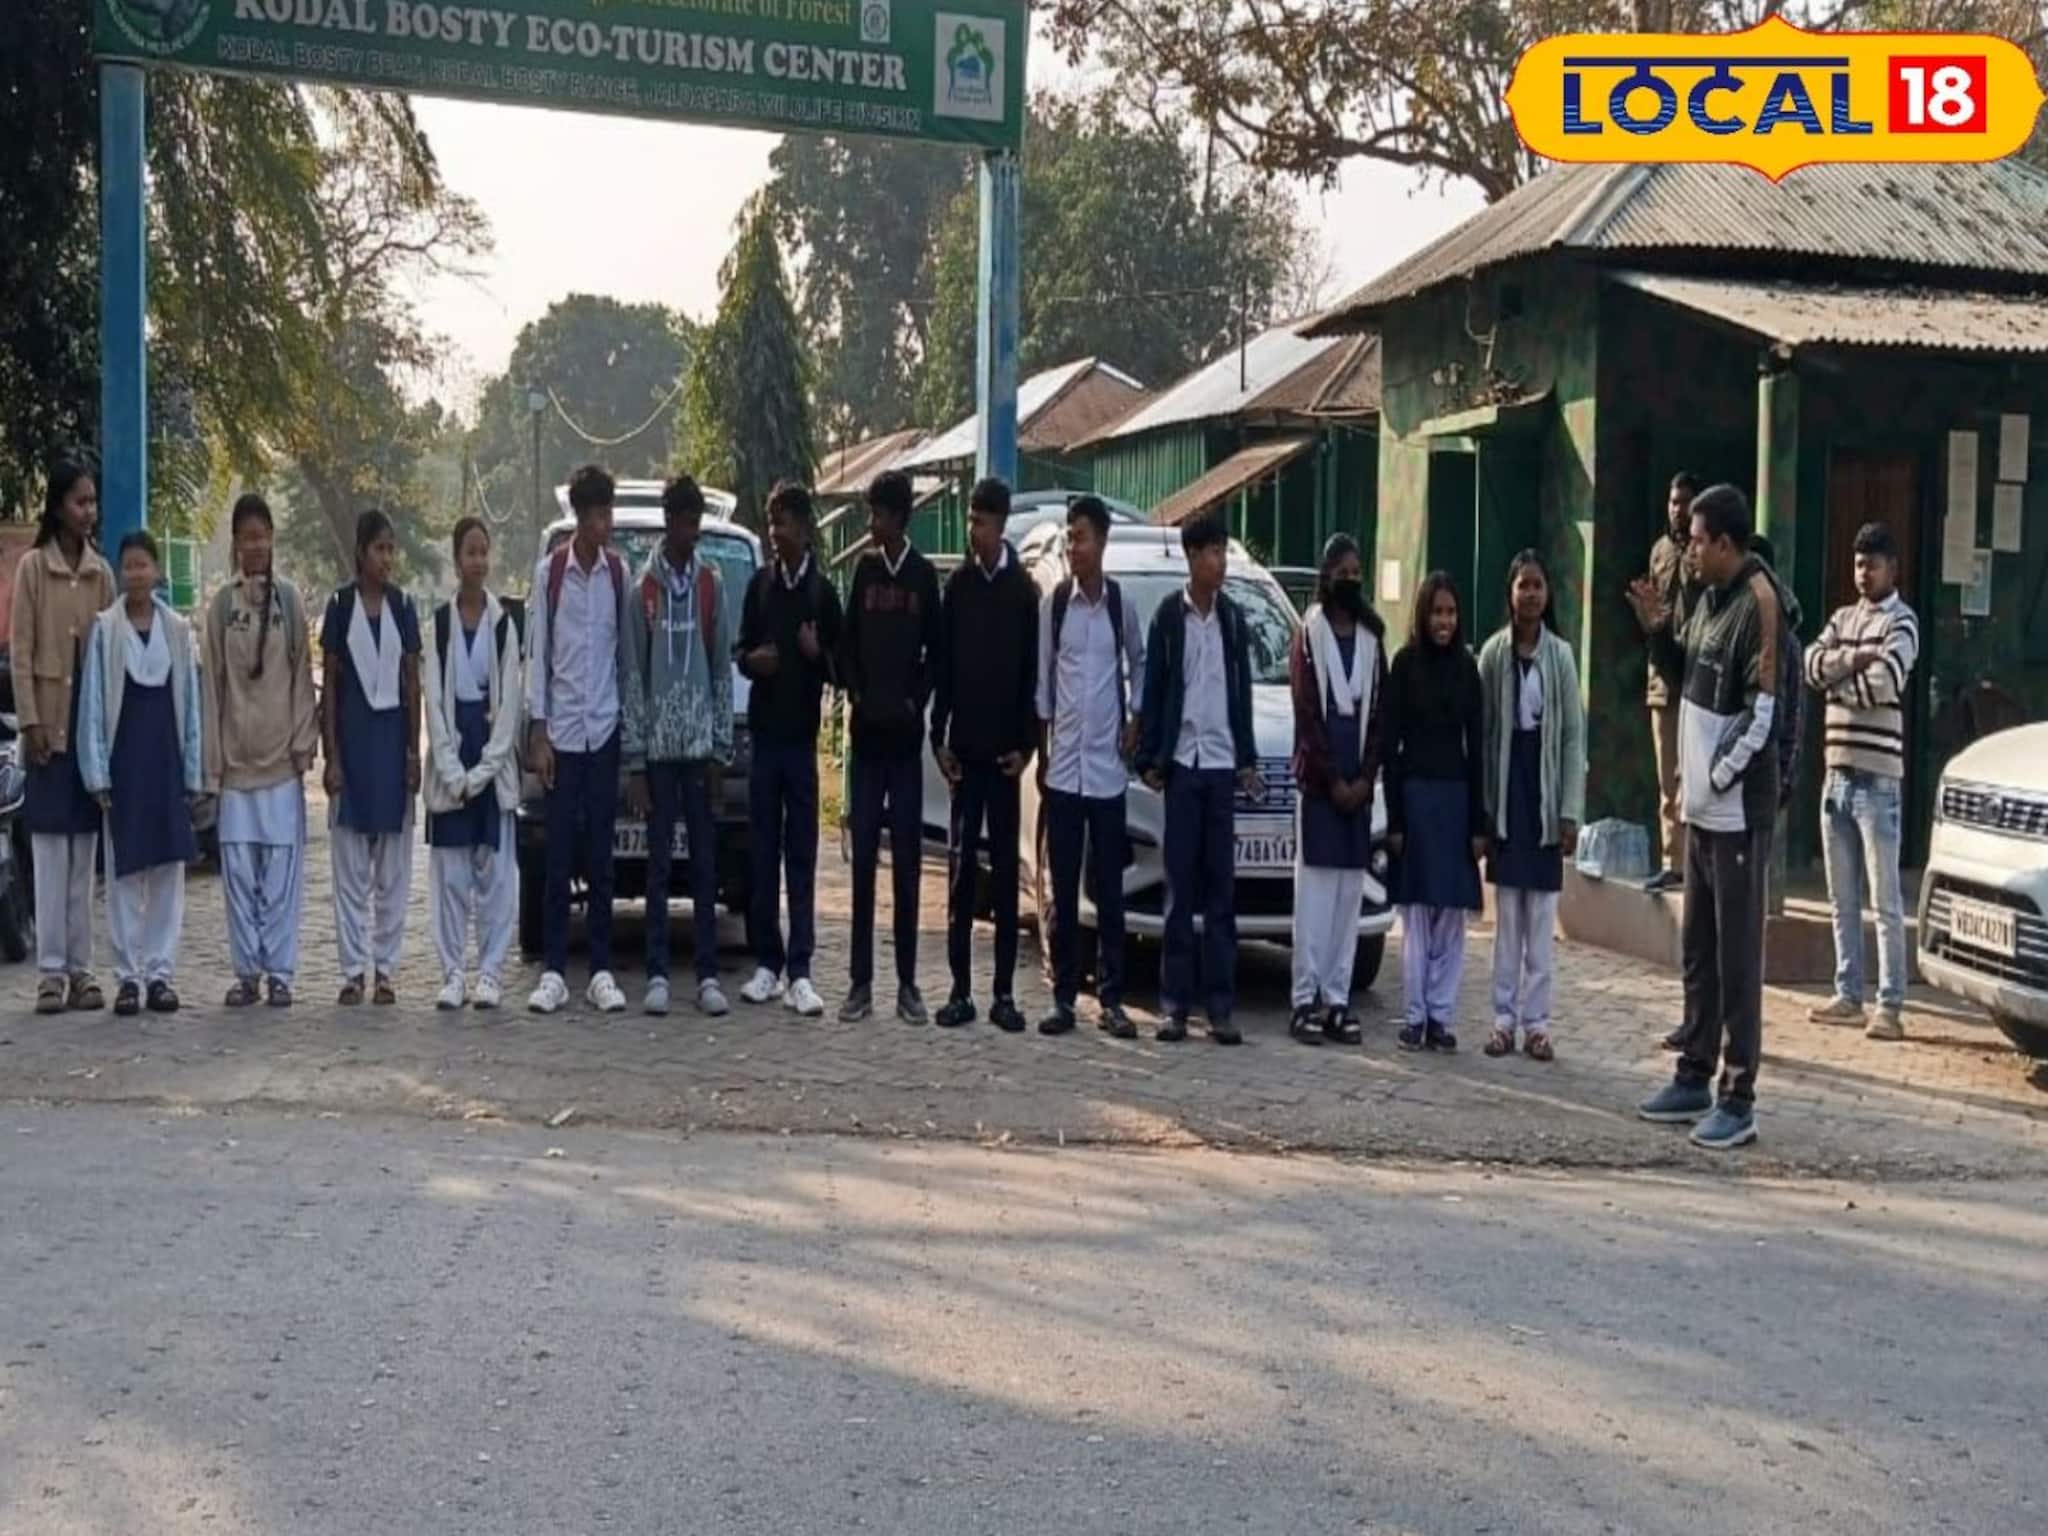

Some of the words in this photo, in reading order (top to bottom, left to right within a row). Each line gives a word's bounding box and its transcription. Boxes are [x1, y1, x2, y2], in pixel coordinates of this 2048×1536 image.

[789, 0, 851, 26] Forest
[235, 0, 376, 33] KODAL
[386, 1, 518, 47] BOSTY
[526, 15, 755, 75] ECO-TURISM
[763, 42, 908, 91] CENTER
